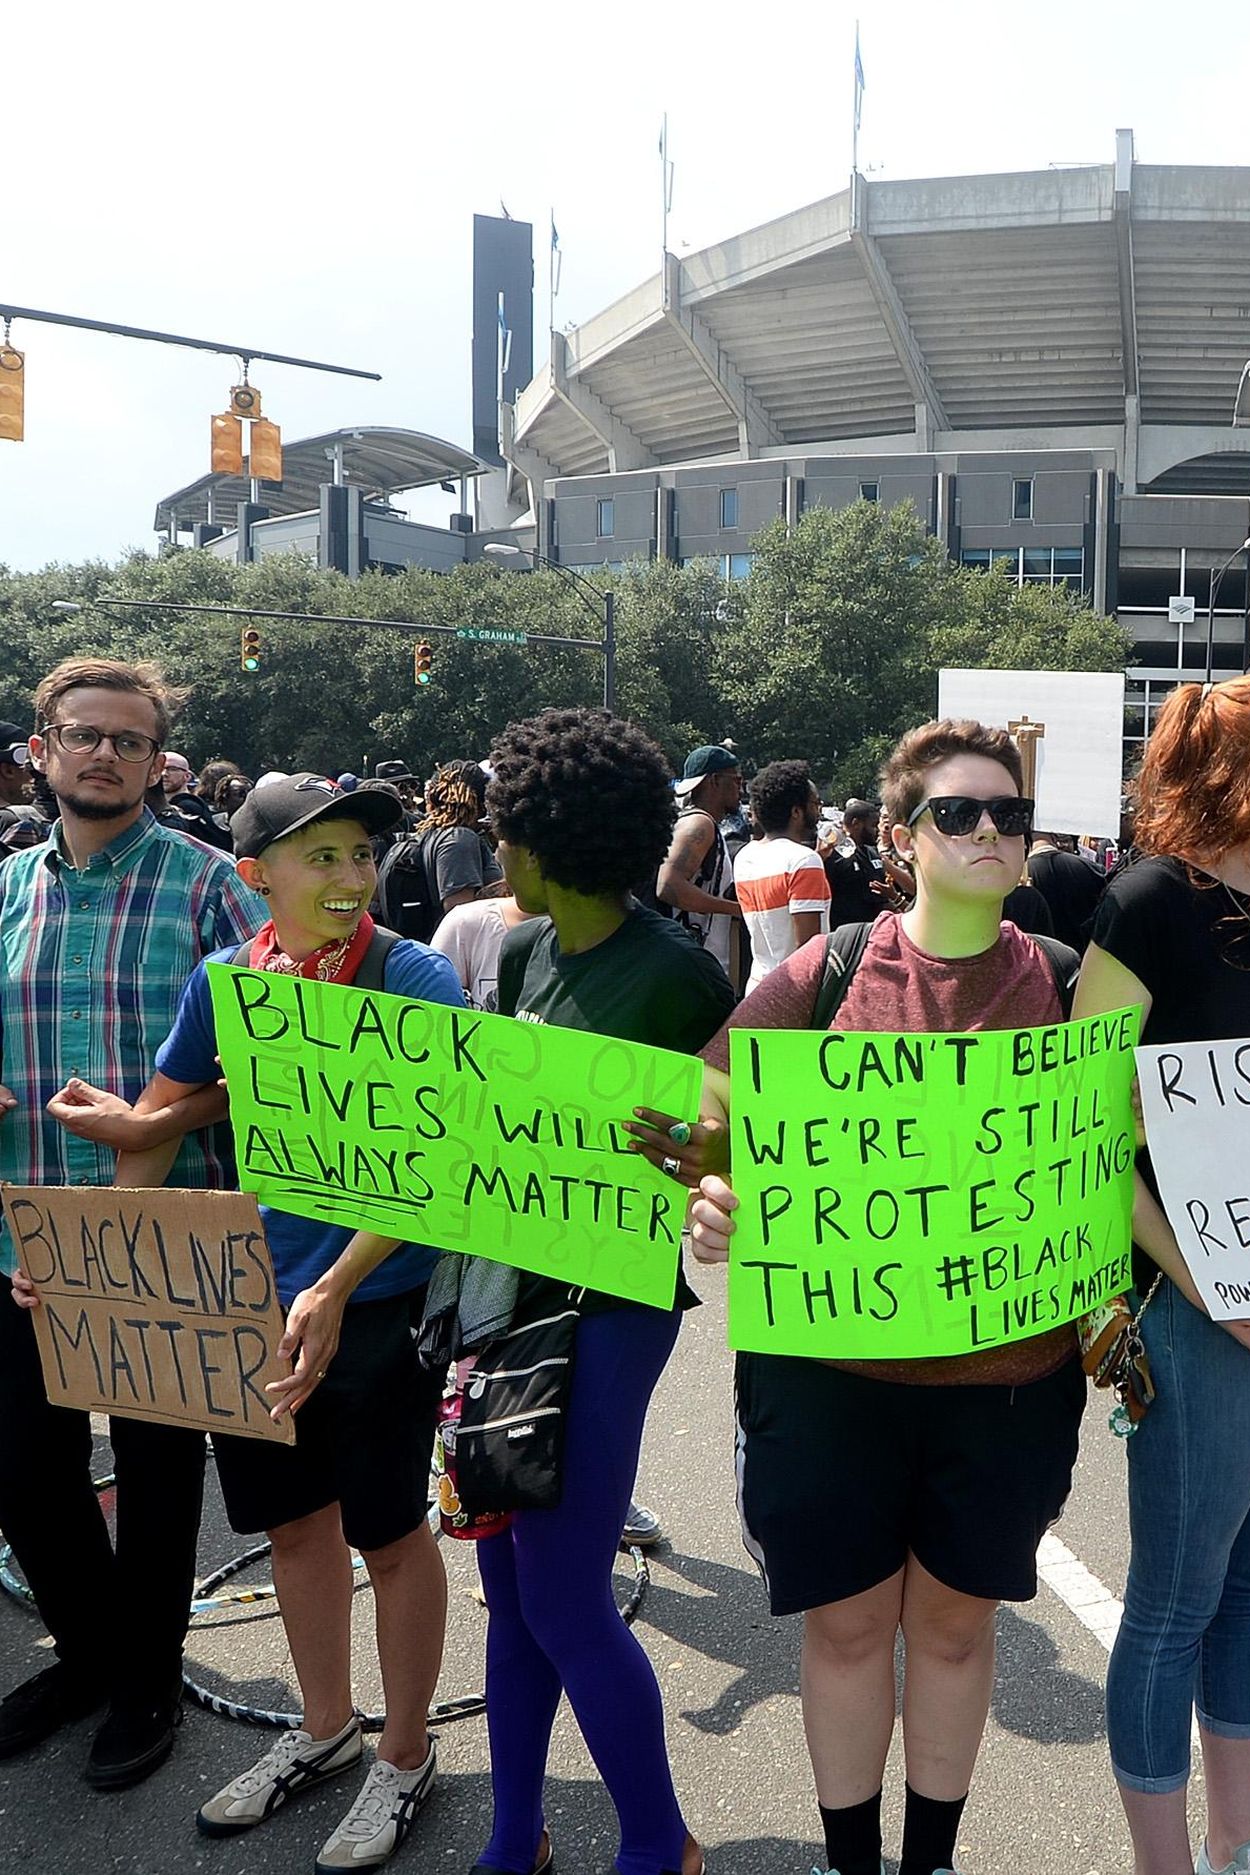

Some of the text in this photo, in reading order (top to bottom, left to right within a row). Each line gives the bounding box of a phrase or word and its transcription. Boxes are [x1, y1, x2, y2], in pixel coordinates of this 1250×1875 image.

[478, 630, 516, 641] GRAHAM
[232, 973, 487, 1081] BLACK
[749, 1012, 1134, 1094] I CAN'T BELIEVE
[251, 1056, 641, 1155] LIVES WILL
[743, 1089, 1104, 1167] WE'RE STILL
[245, 1125, 674, 1243] ALWAYS MATTER
[759, 1131, 1131, 1246] PROTESTING
[10, 1200, 271, 1314] BLACK LIVES
[740, 1260, 903, 1327] THIS
[936, 1222, 1094, 1301] #BLACK
[970, 1285, 1060, 1346] LIVES
[1068, 1252, 1130, 1316] MATTER
[46, 1304, 281, 1425] MATTER
